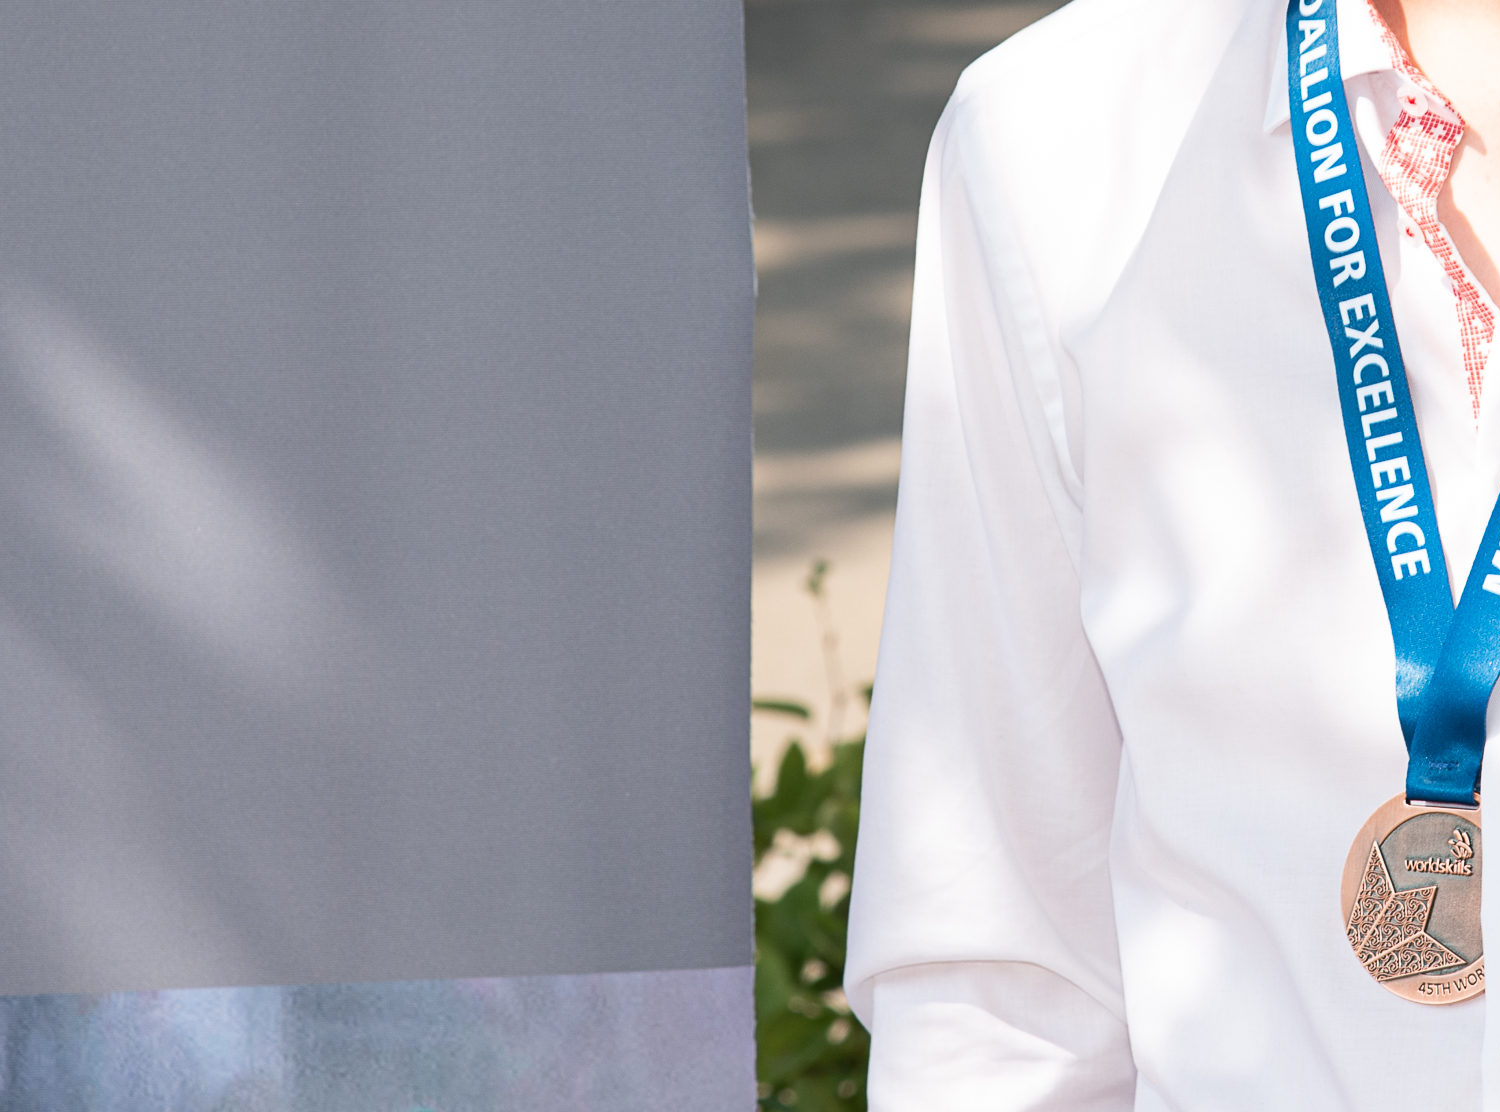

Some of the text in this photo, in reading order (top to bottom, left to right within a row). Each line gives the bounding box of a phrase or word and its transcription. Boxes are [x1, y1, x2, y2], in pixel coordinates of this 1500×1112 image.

[1318, 188, 1367, 288] FOR
[1338, 292, 1432, 581] EXCELLENCE
[1404, 856, 1473, 876] worldskills
[1418, 965, 1485, 995] 45TH WOR
